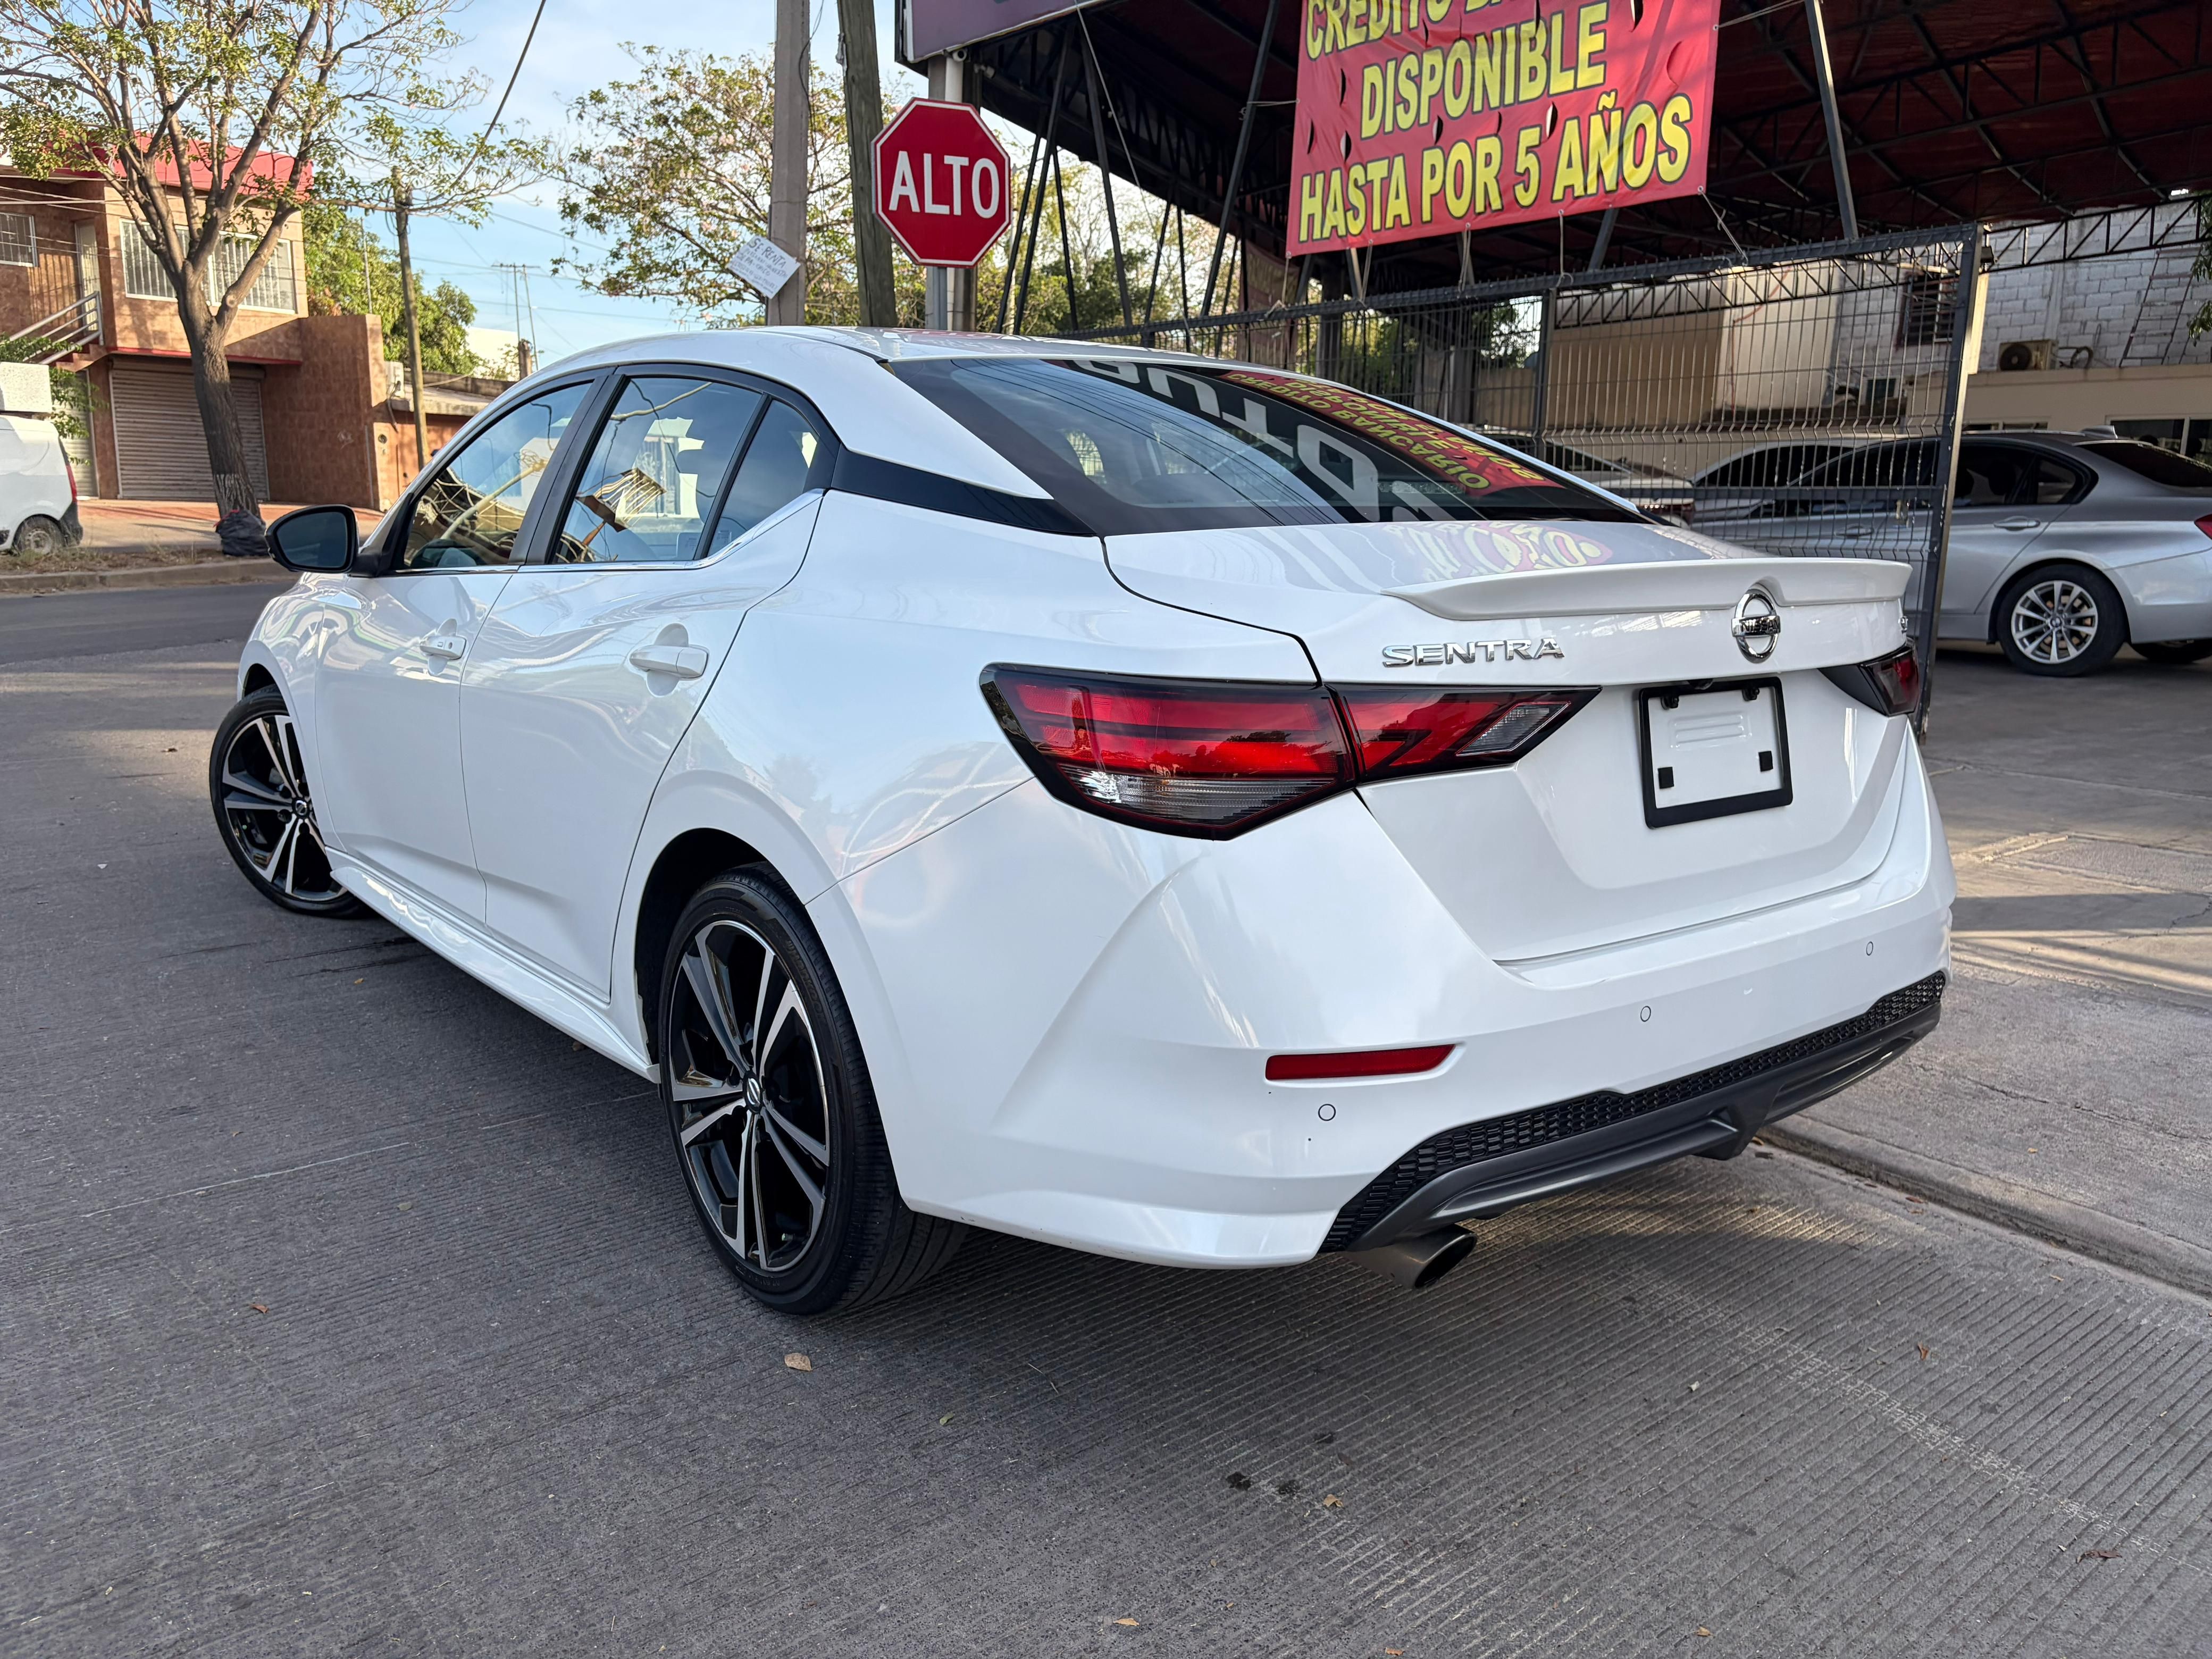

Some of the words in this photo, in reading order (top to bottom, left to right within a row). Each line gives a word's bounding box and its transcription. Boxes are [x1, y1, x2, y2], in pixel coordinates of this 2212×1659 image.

[1360, 2, 1608, 140] DISPONIBLE
[889, 150, 1000, 219] ALTO
[1298, 154, 1411, 243] HASTA
[1421, 133, 1504, 224] POR
[1513, 125, 1541, 208] 5
[1551, 90, 1693, 203] AÑOS
[761, 247, 786, 268] RENTA
[1740, 616, 1779, 633] NISSAN
[1382, 638, 1565, 668] SENTRA
